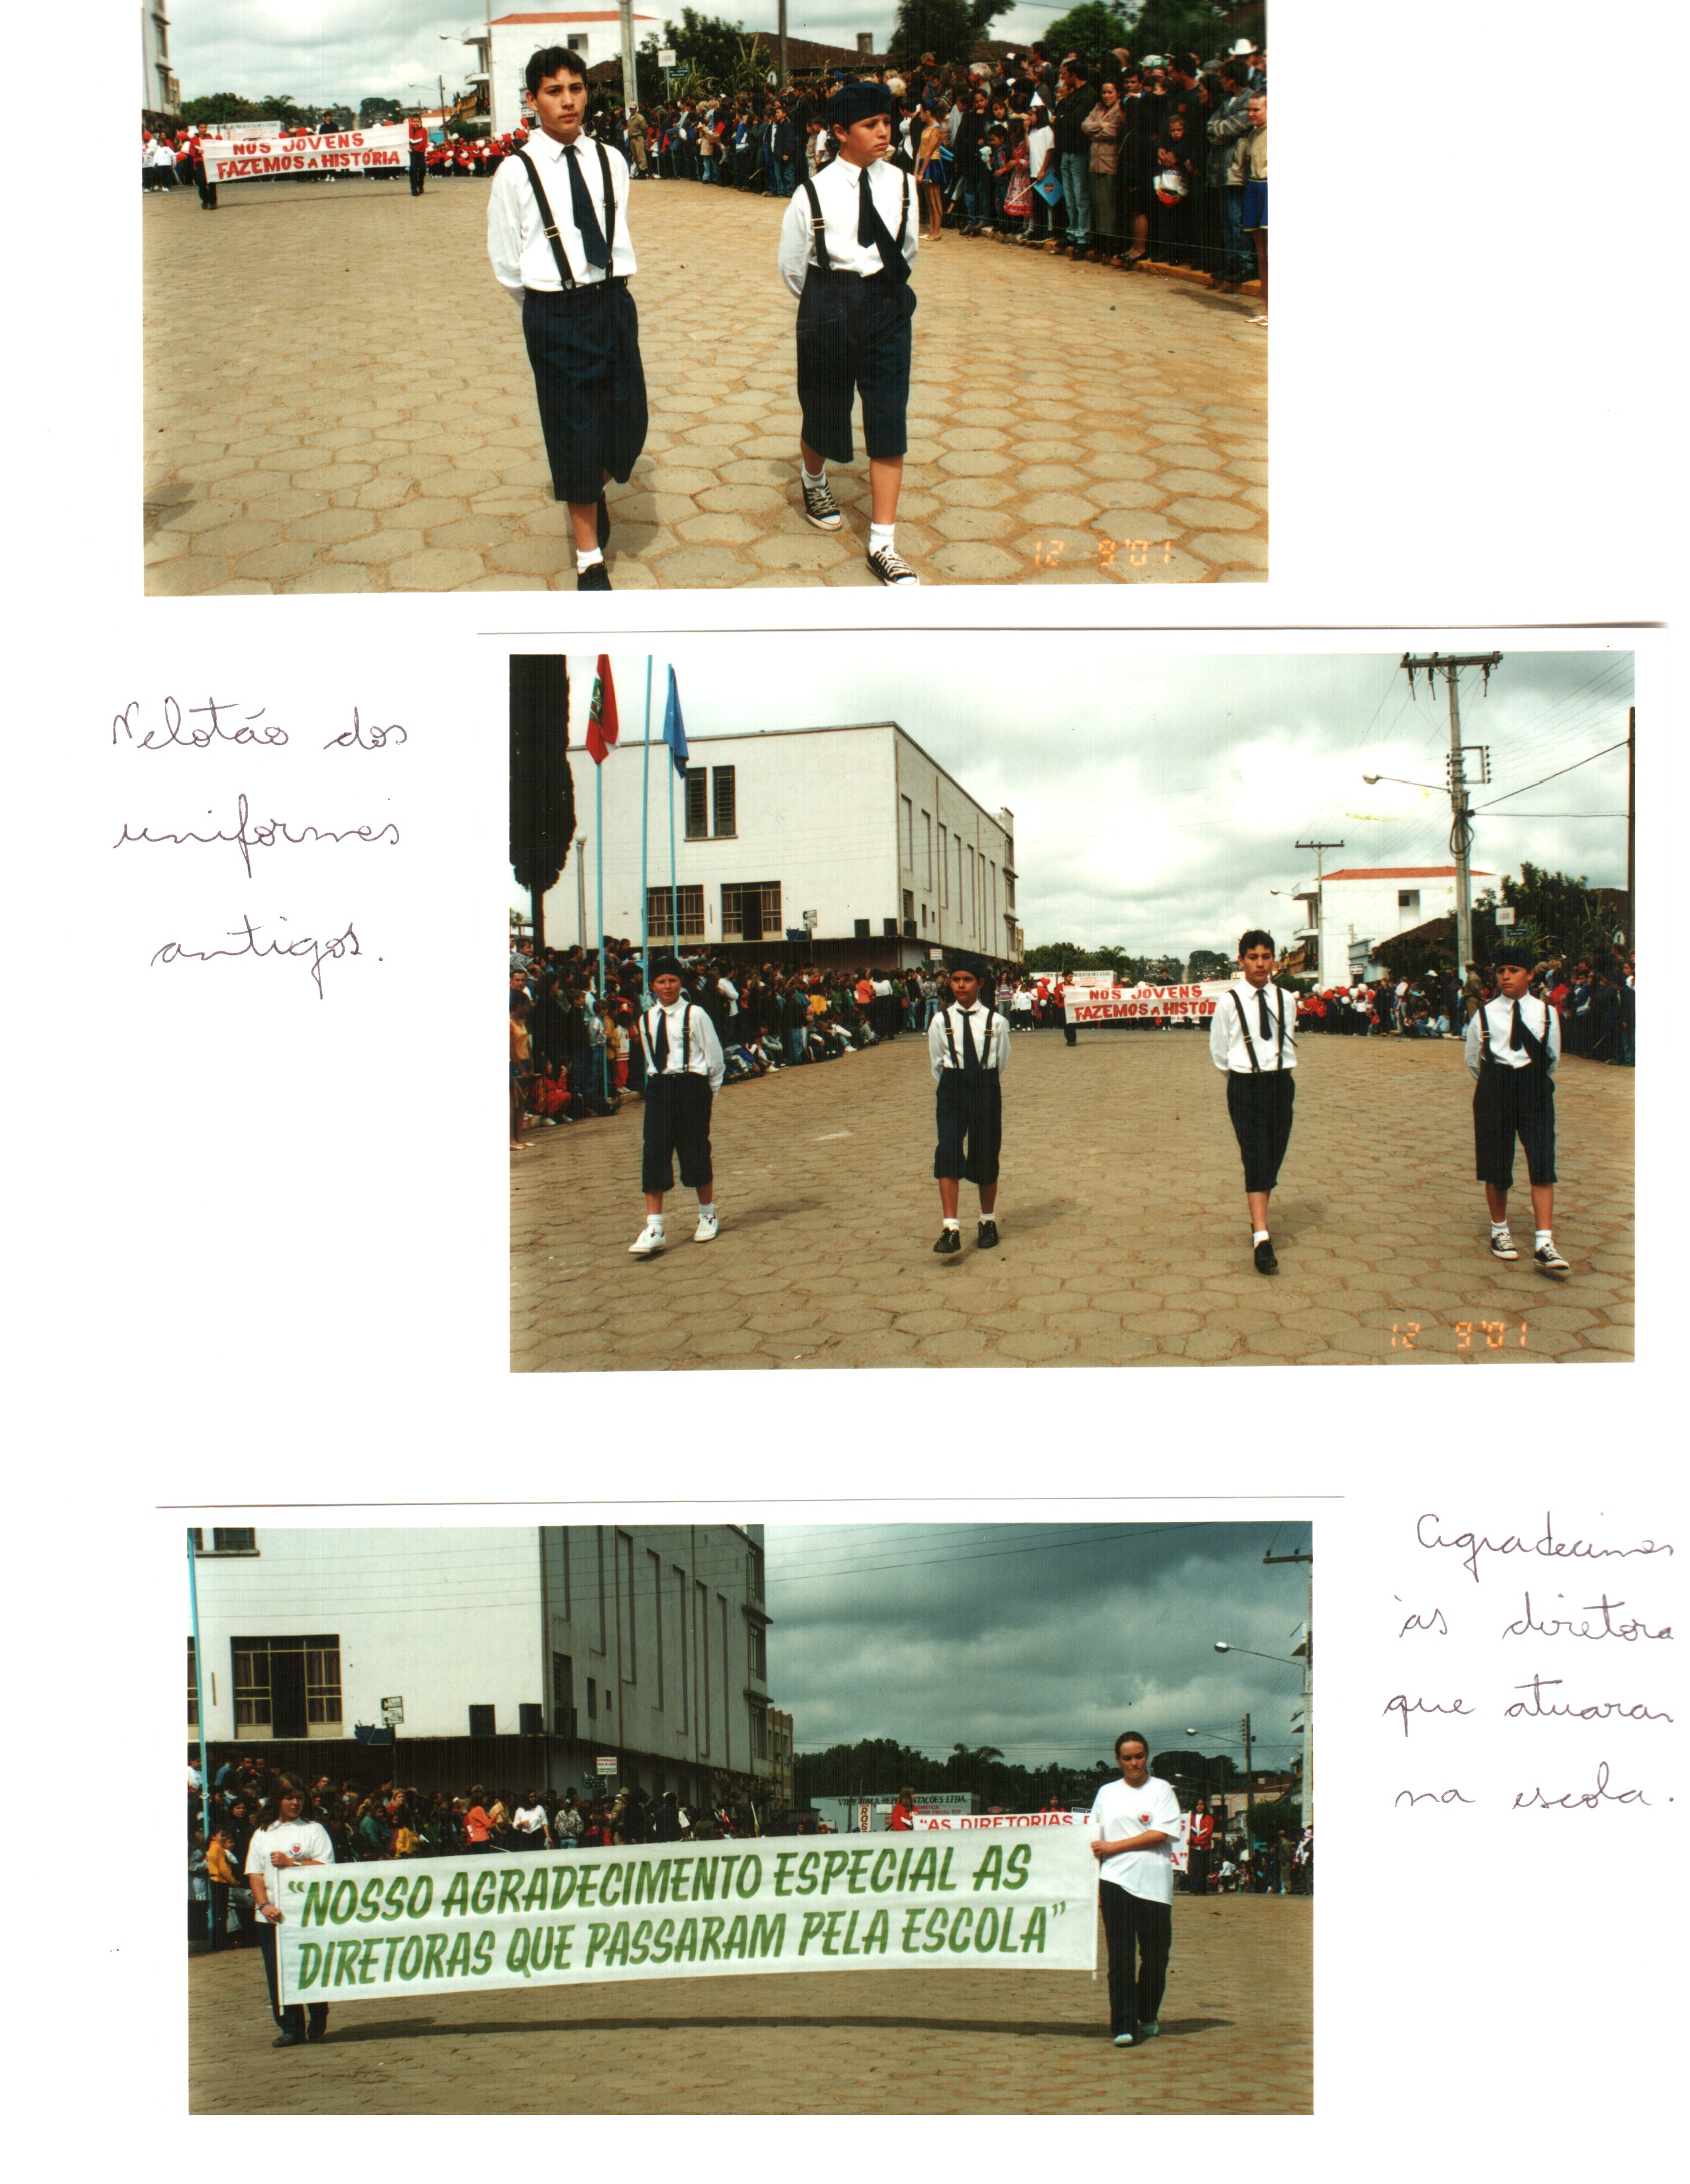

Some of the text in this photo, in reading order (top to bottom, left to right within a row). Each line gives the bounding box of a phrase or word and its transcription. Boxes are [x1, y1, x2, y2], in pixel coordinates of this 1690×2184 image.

[282, 133, 364, 152] JOVENS
[216, 149, 400, 180] FAZEMOS A HISTÓRIA
[323, 707, 407, 750] dos
[113, 793, 399, 878] uniformes
[151, 915, 383, 1000] antigos.
[1074, 999, 1217, 1021] FAZEMOS A HISTÓR
[1131, 985, 1203, 1000] JOVENS
[1384, 1695, 1473, 1737] que
[1396, 1789, 1475, 1806] na
[961, 1815, 1073, 1829] DIRETORIAS
[288, 1844, 1032, 1928] “NOSSO AGRADECIMENTO ESPECIAL AS
[298, 1900, 1066, 1990] DIRETORAS QUE PASSARAM PELA ESCOLA”
